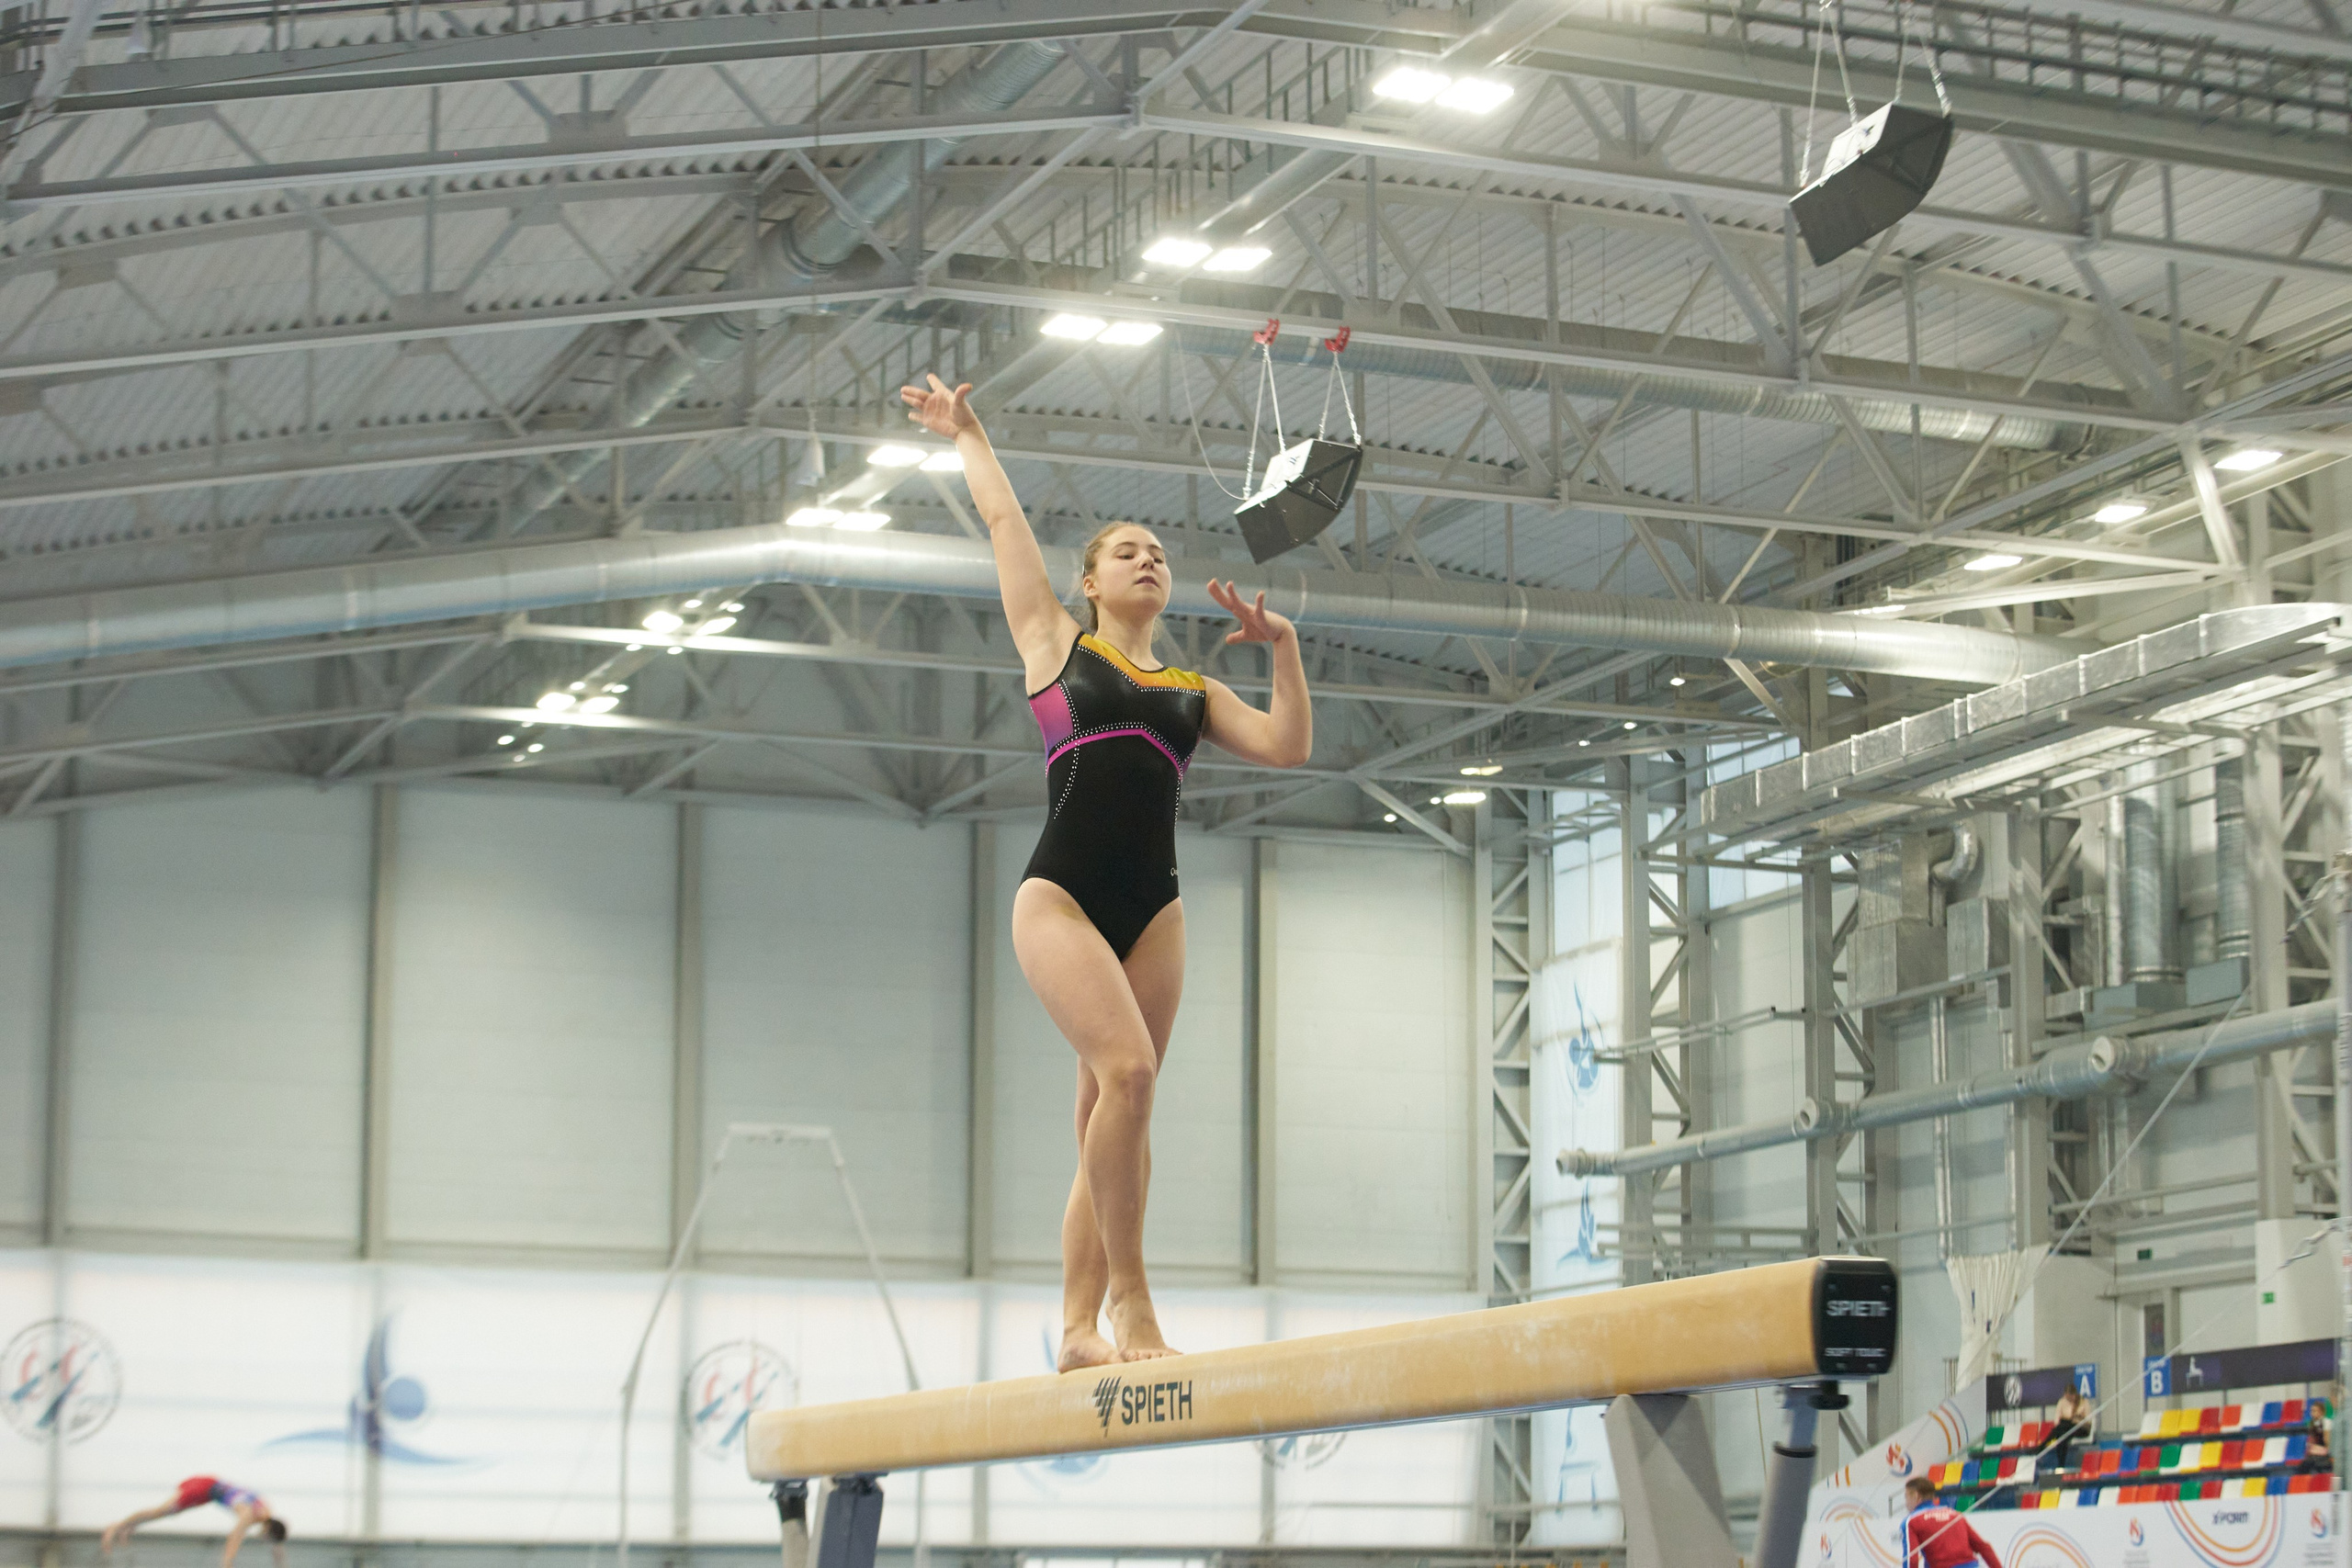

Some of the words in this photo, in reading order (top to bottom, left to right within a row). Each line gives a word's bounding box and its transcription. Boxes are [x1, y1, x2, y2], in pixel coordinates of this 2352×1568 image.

[1826, 1300, 1890, 1317] SPIETH
[1855, 1348, 1888, 1358] TOUC
[1121, 1380, 1193, 1426] SPIETH
